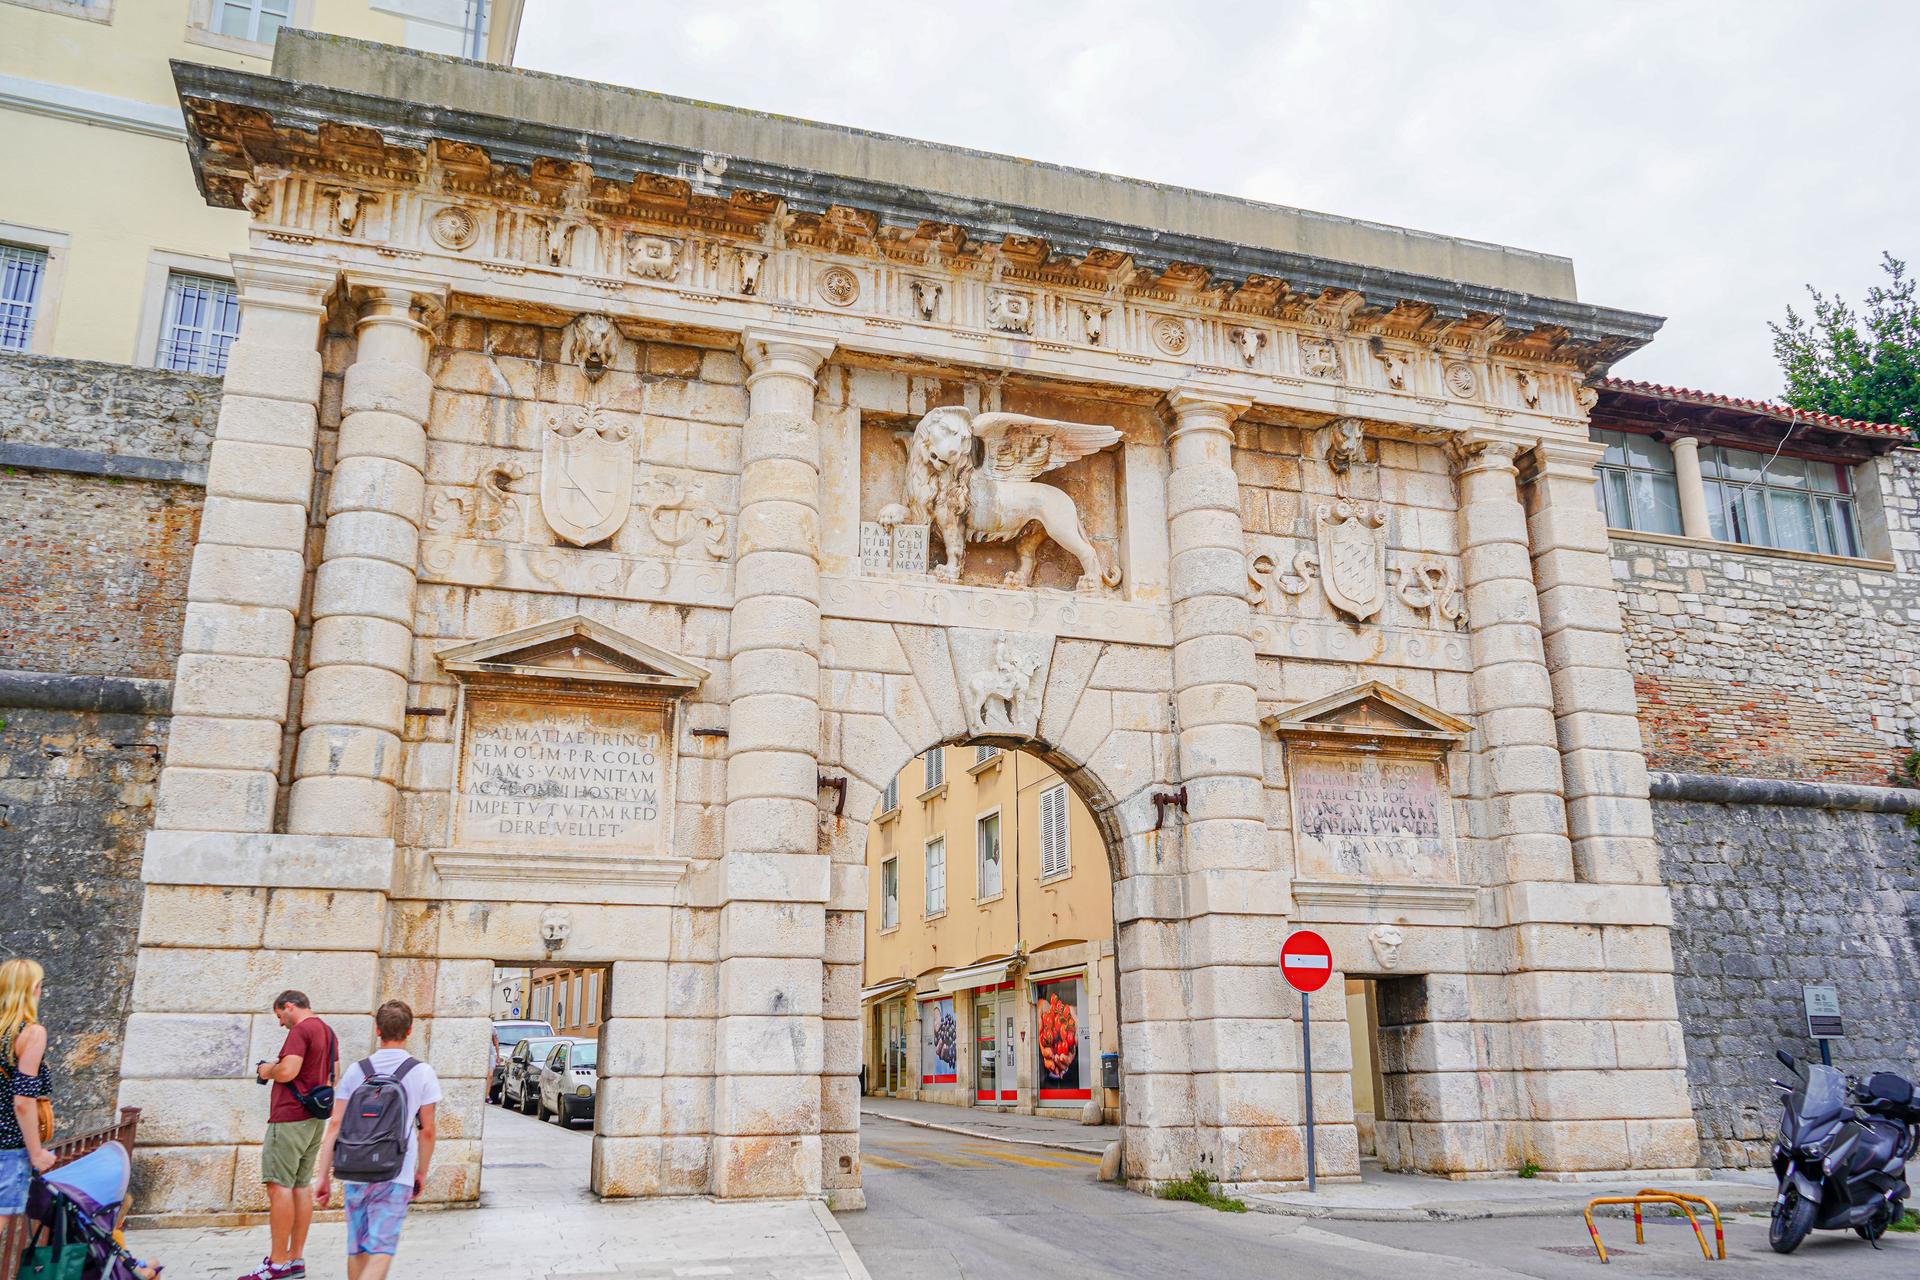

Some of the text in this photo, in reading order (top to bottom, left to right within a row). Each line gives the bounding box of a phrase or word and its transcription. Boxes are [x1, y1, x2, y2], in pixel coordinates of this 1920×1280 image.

[864, 537, 890, 547] TIBI
[899, 550, 921, 560] STA
[896, 561, 924, 569] MEVS
[476, 727, 655, 749] DALMATIAE PRINCI
[475, 744, 508, 758] PEM
[621, 807, 657, 821] RED
[500, 820, 547, 835] DERE
